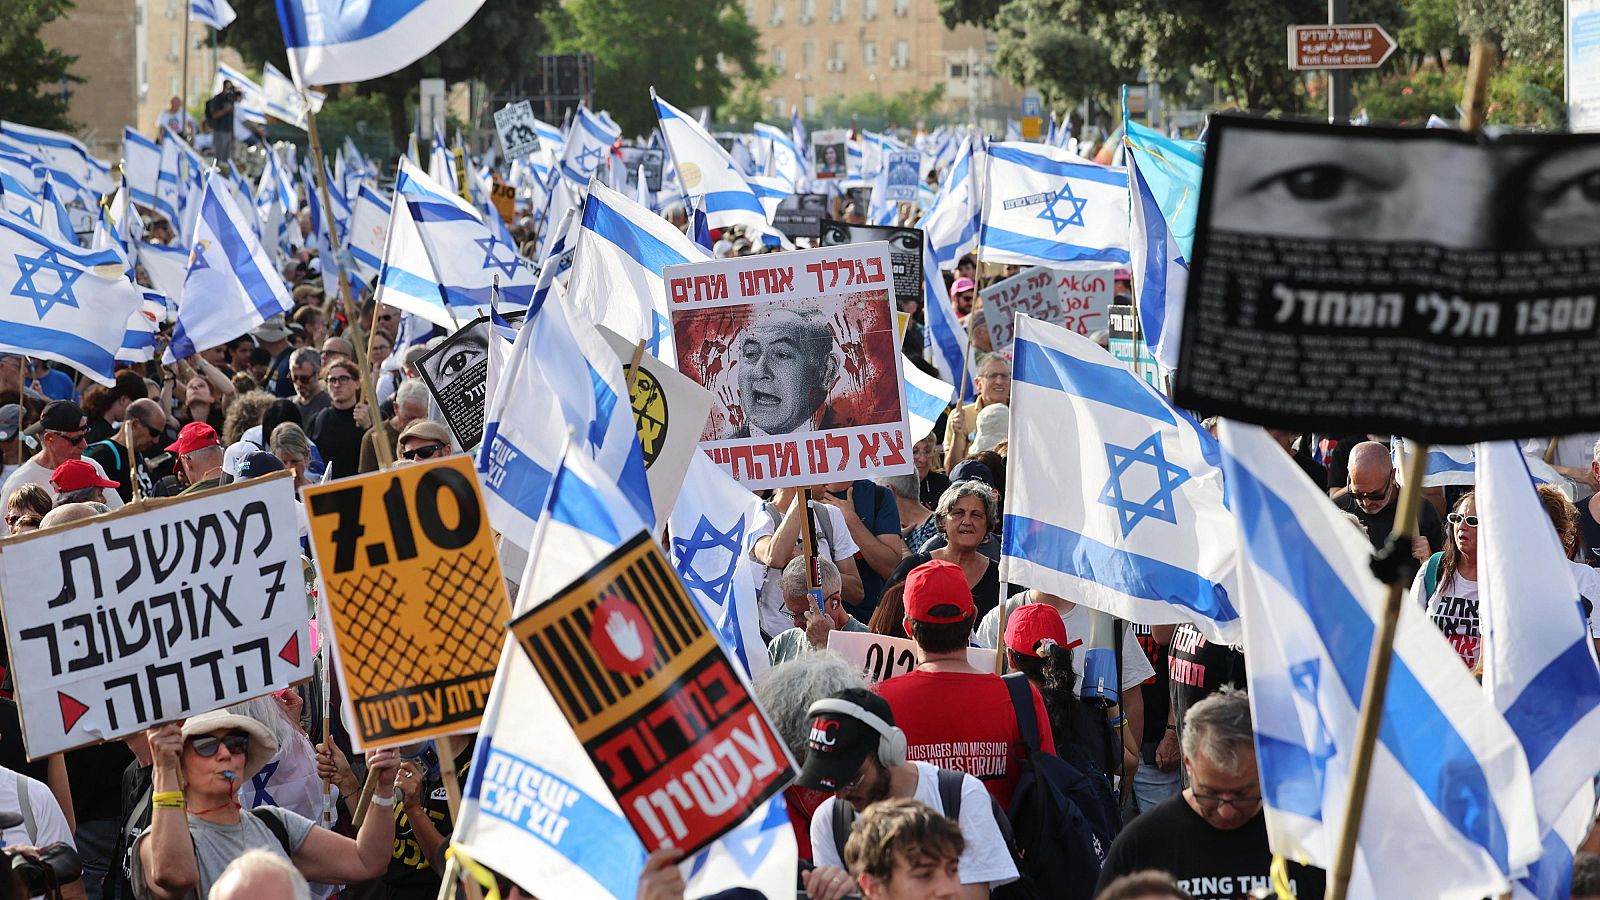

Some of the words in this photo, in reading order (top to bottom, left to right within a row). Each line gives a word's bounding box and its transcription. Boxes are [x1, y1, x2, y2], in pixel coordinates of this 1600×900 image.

[1343, 54, 1372, 64] Garden
[670, 273, 728, 304] מתים
[738, 266, 794, 297] אנחנו
[807, 257, 885, 292] בגללך
[1271, 282, 1404, 328] המחדל
[1416, 291, 1501, 338] חללי
[464, 380, 486, 402] חדל
[704, 441, 800, 481] מהחיי
[806, 433, 850, 474] לנו
[857, 430, 906, 468] צא
[309, 466, 481, 574] 7.10
[48, 500, 273, 609] ממשלת
[259, 560, 287, 620] 7
[1436, 596, 1479, 618] אתה
[104, 637, 274, 731] הדחה
[448, 676, 493, 715] ירות
[594, 659, 748, 790] בחירות
[907, 743, 951, 759] HOSTAGES
[952, 742, 969, 756] AND
[969, 741, 1008, 756] MISSING
[966, 756, 1007, 777] FORUM
[633, 713, 778, 849] עכשיו!
[1177, 877, 1234, 896] RING
